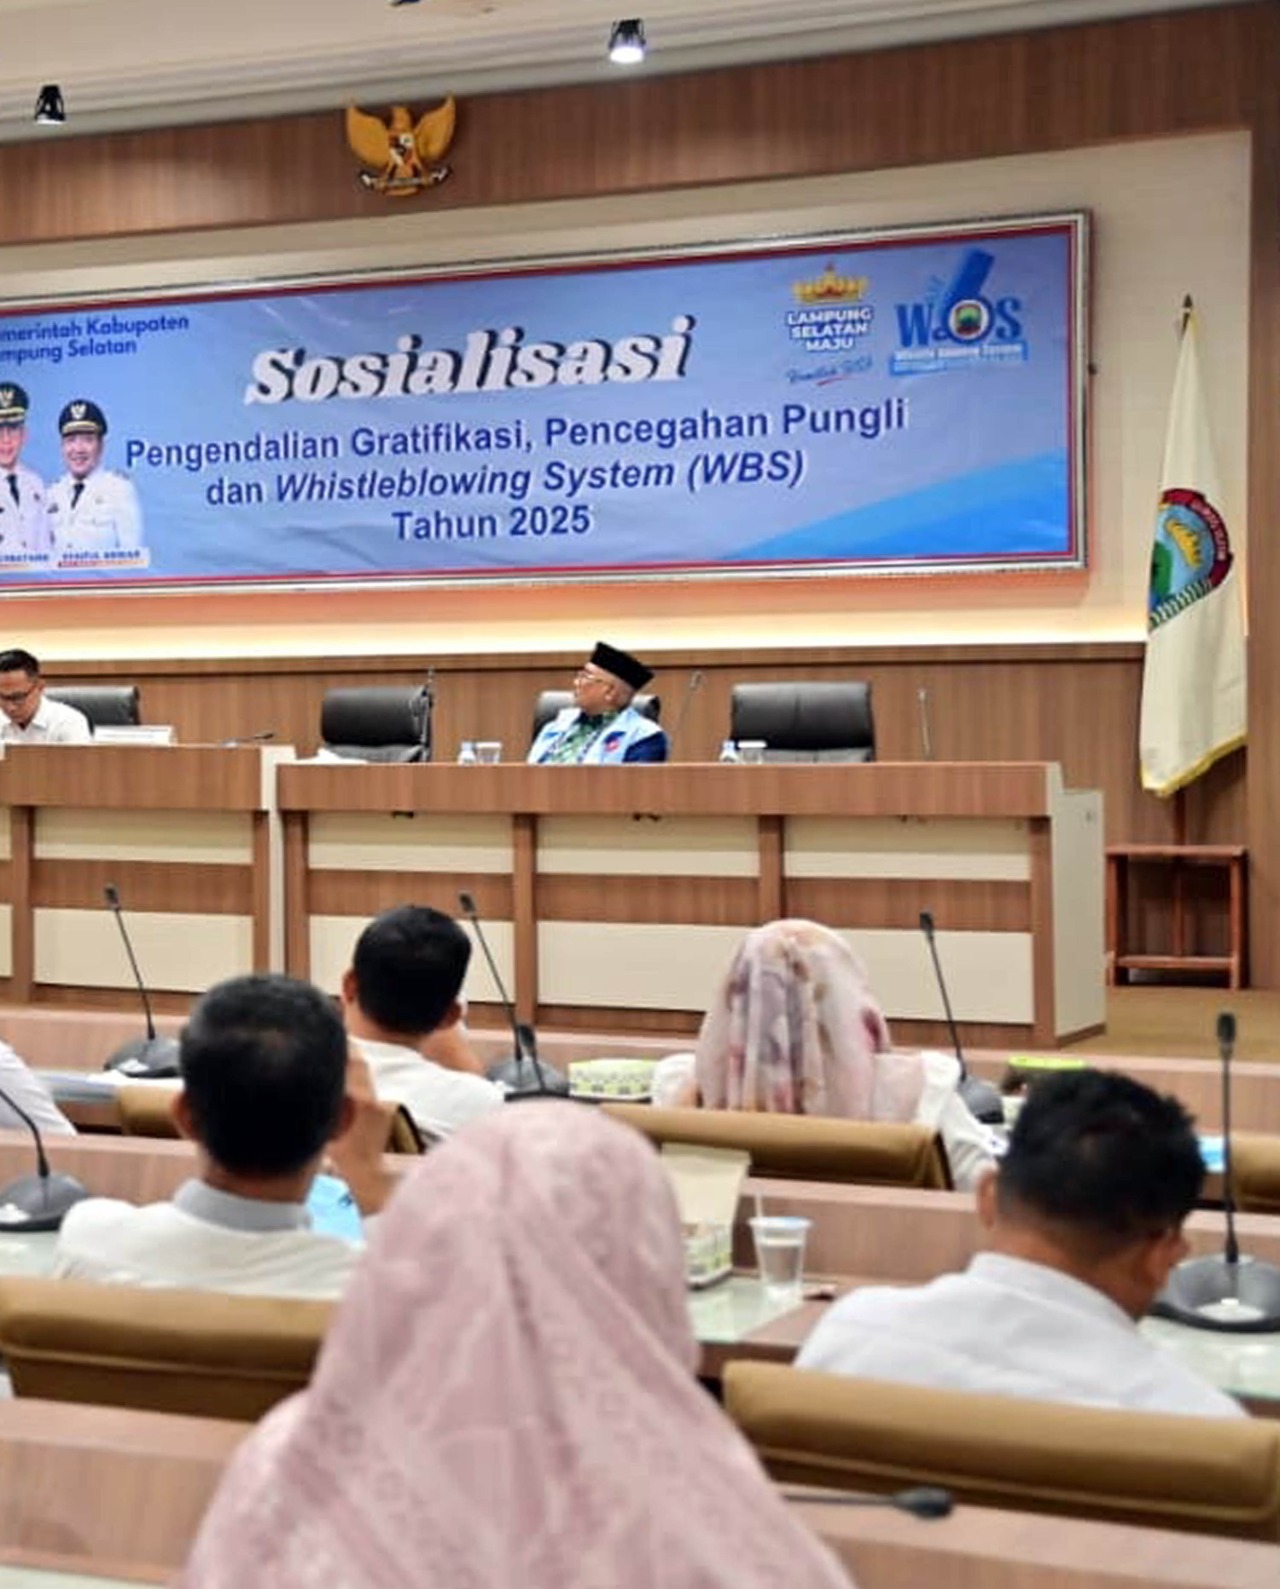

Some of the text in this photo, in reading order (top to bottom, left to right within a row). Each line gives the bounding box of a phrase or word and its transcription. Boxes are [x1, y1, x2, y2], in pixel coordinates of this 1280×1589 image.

[86, 314, 189, 337] Kabupaten
[786, 307, 874, 326] LAMPUNG
[790, 322, 869, 340] SELATAN
[67, 338, 137, 358] Selatan
[805, 337, 854, 352] MAJU
[244, 314, 696, 406] Sosialisasi
[125, 398, 906, 473] Pengendalian Gratifikasi, Pencegahan Pungli
[207, 450, 805, 506] dan Whistleblowing System (WBS)
[393, 504, 591, 542] Tahun 2025
